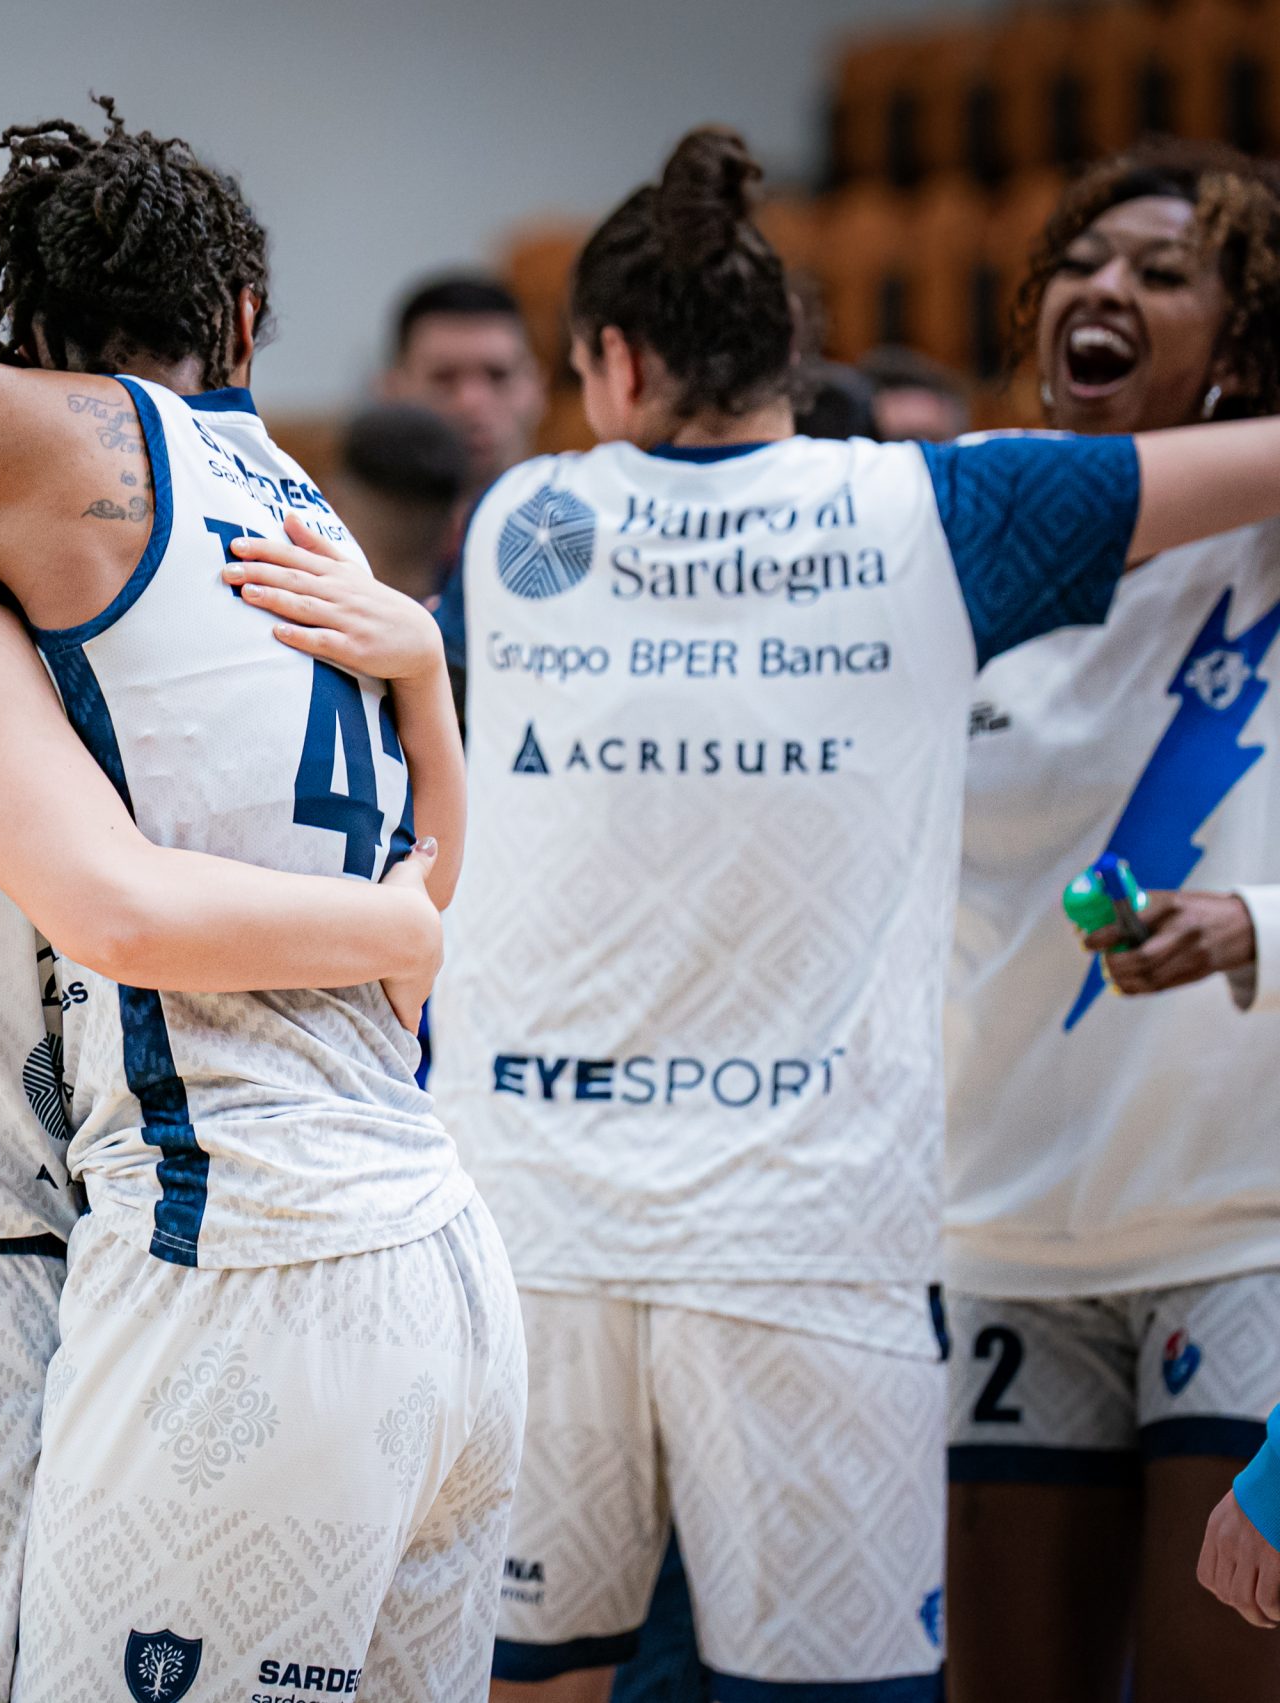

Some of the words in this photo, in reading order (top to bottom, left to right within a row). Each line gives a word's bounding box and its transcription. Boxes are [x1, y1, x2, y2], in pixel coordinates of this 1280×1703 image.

[609, 545, 887, 607] Sardegna
[488, 632, 610, 682] Gruppo
[629, 638, 738, 677] BPER
[759, 640, 892, 677] Banca
[565, 737, 841, 776] ACRISURE
[973, 1324, 1024, 1424] 2
